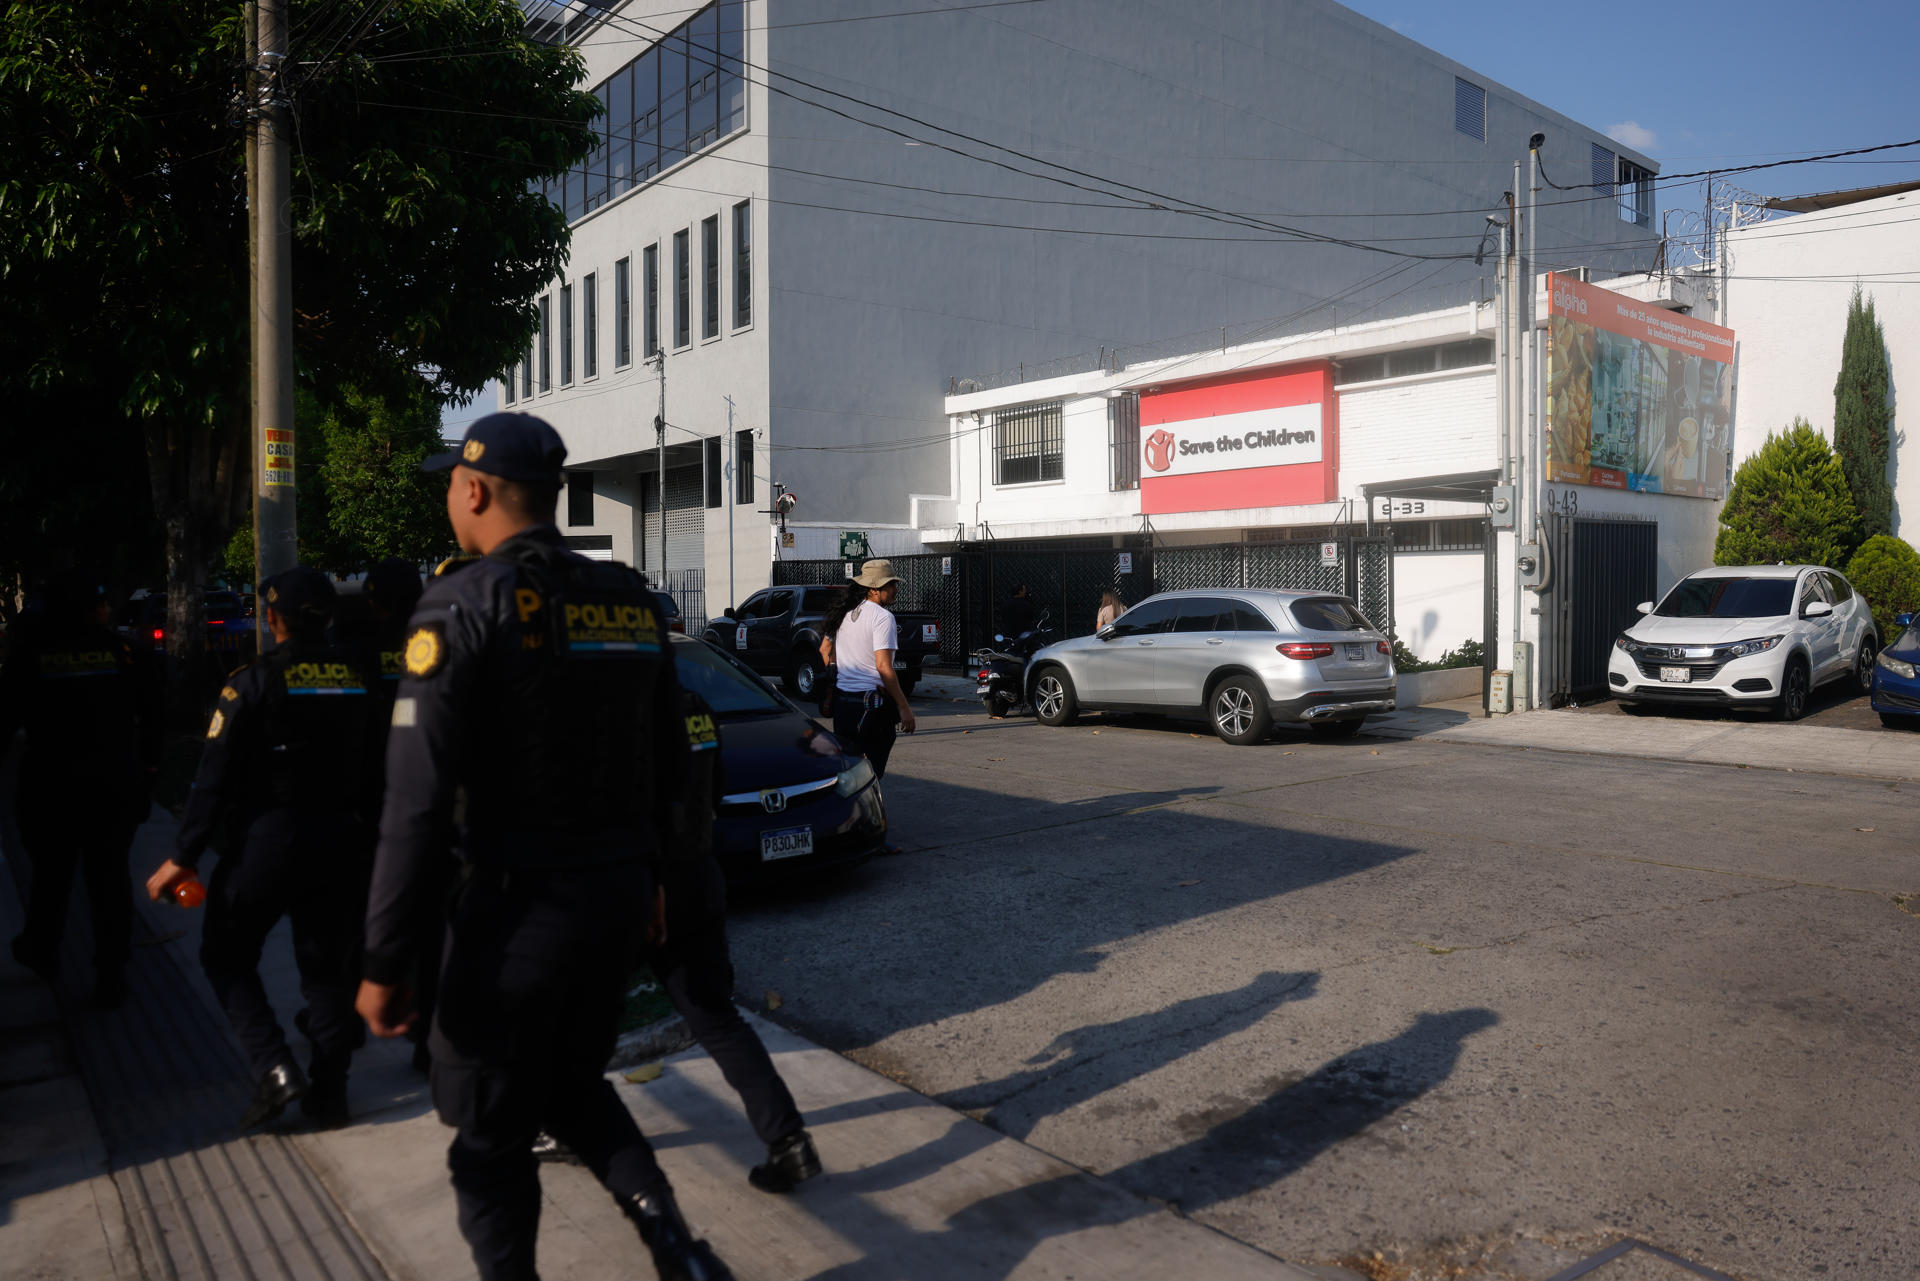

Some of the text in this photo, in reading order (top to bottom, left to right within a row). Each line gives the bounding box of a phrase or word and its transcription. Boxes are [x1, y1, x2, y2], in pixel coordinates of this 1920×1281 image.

[1554, 287, 1588, 317] alpha
[1630, 309, 1637, 320] de
[267, 443, 293, 457] CASA
[1179, 428, 1315, 456] Save the Children
[1381, 502, 1425, 515] 9-33
[1547, 488, 1578, 516] 9-43
[564, 603, 659, 630] POLICIA
[764, 831, 810, 855] P830JHK
